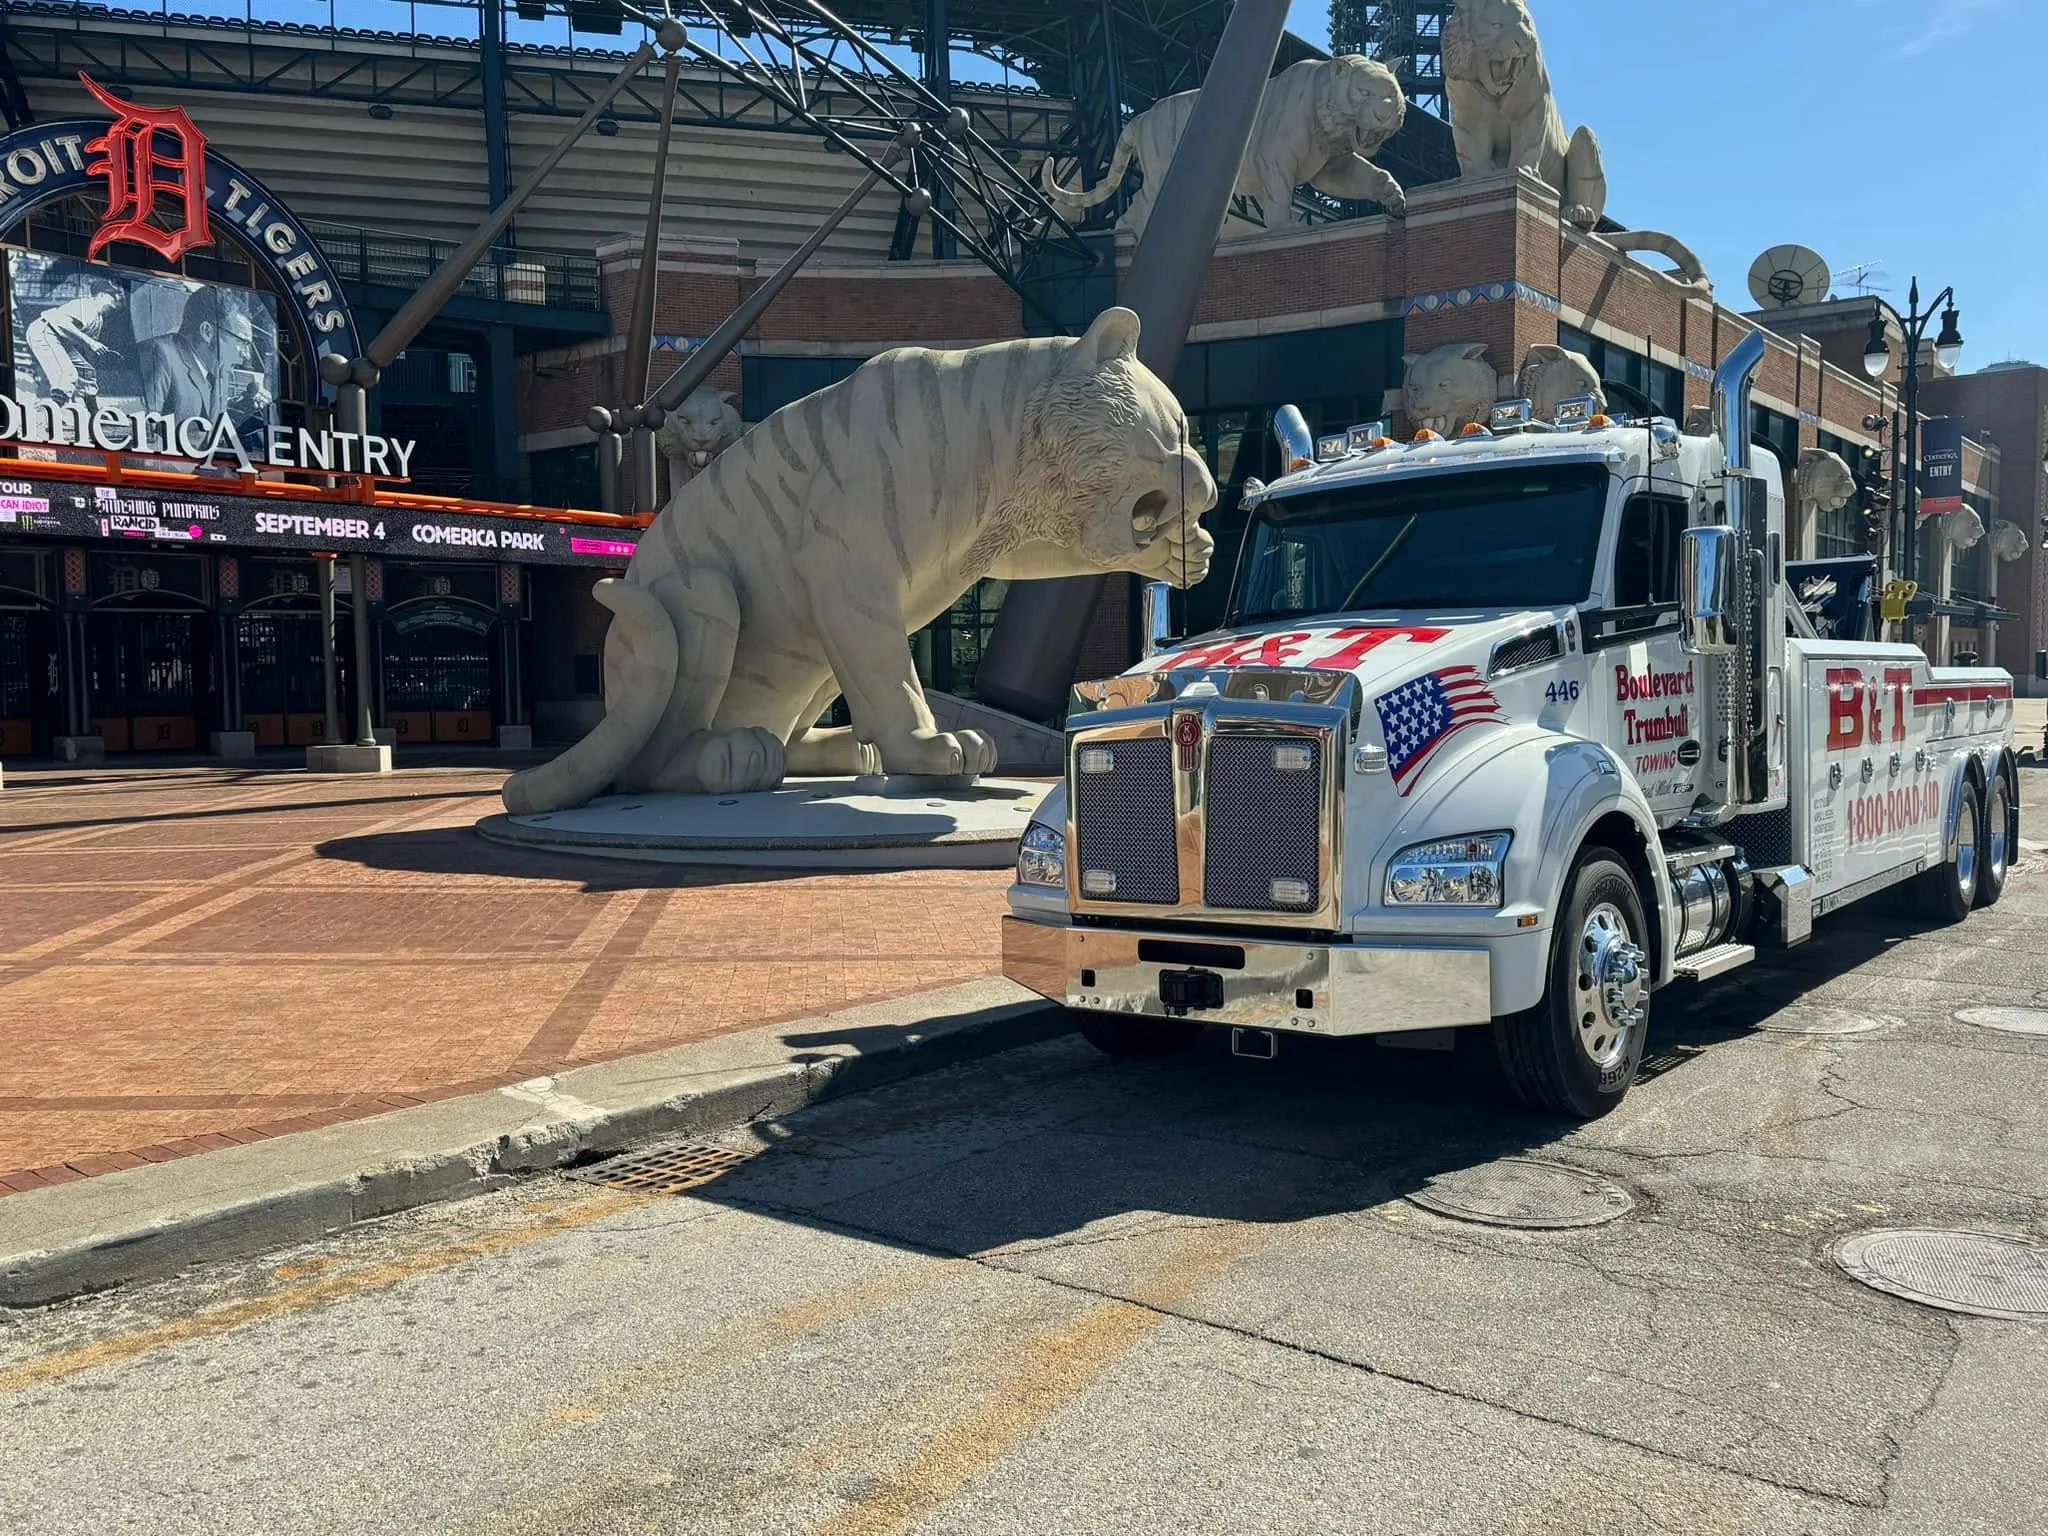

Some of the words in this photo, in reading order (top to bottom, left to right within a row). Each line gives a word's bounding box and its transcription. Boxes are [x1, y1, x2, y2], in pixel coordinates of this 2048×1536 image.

[224, 179, 345, 333] TIGERS
[269, 425, 416, 478] ENTRY
[1929, 465, 1953, 477] ENTRY
[0, 482, 32, 494] OUR
[22, 501, 48, 510] IDIOT
[113, 516, 157, 530] RANCID
[255, 512, 369, 539] SEPTEMBER
[373, 522, 386, 540] 4
[412, 525, 497, 548] COMERICA
[501, 531, 544, 551] PARK
[1545, 680, 1579, 702] 446
[1615, 660, 1695, 701] Boulevard
[1624, 704, 1689, 745] Trumbull
[1635, 751, 1676, 775] TOWING
